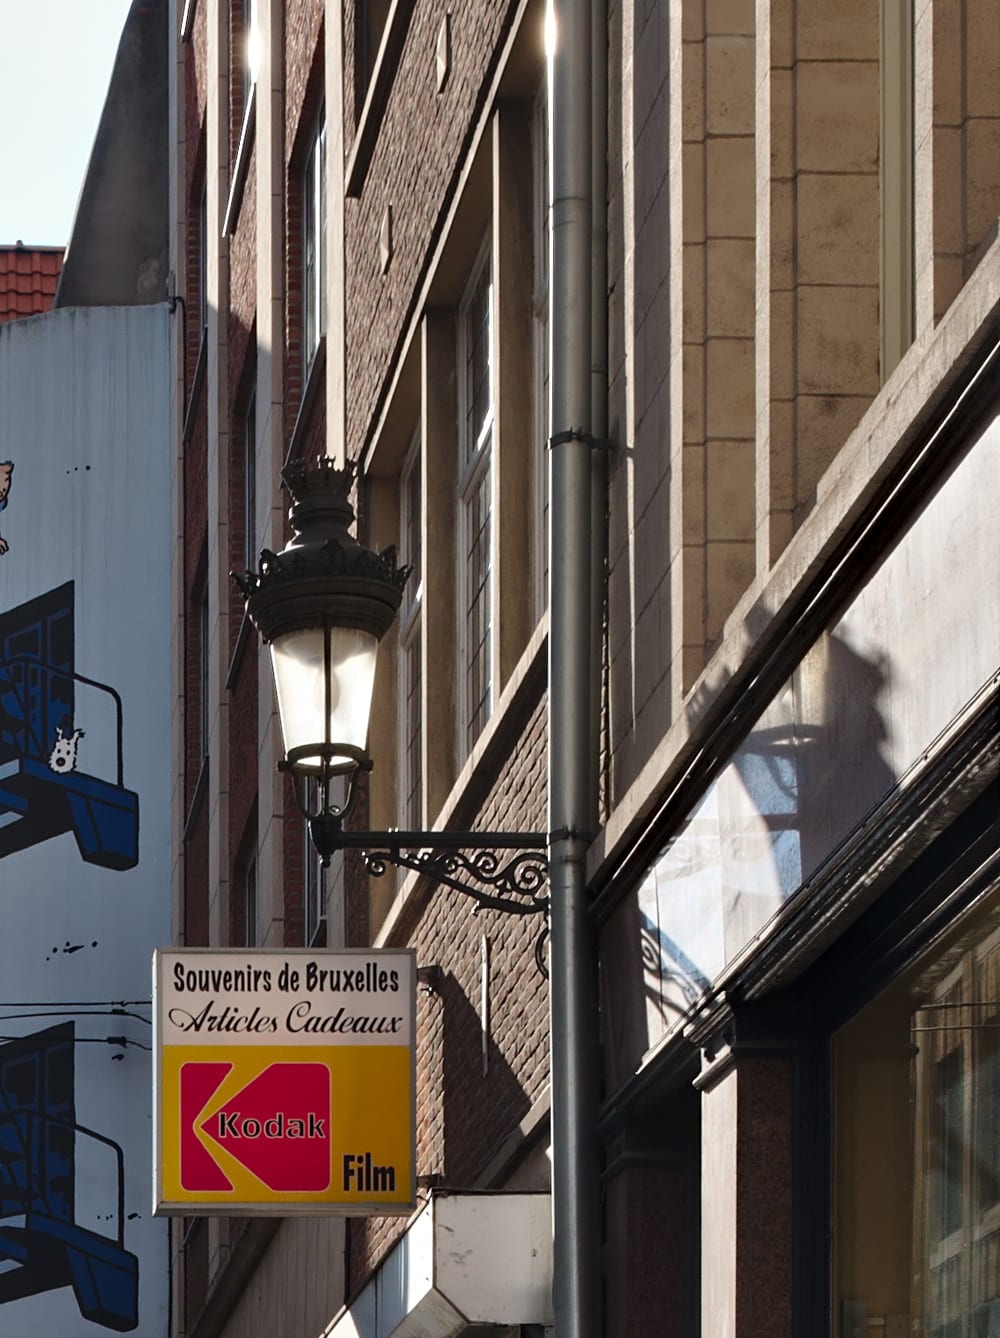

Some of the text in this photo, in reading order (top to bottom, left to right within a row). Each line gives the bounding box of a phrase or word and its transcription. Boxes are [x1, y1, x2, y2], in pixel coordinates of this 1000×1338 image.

[174, 962, 399, 993] Souvenirs de Bruxelles
[168, 1000, 403, 1034] Articles Cadeaux
[218, 1112, 326, 1138] Kodak
[343, 1152, 395, 1192] Film
